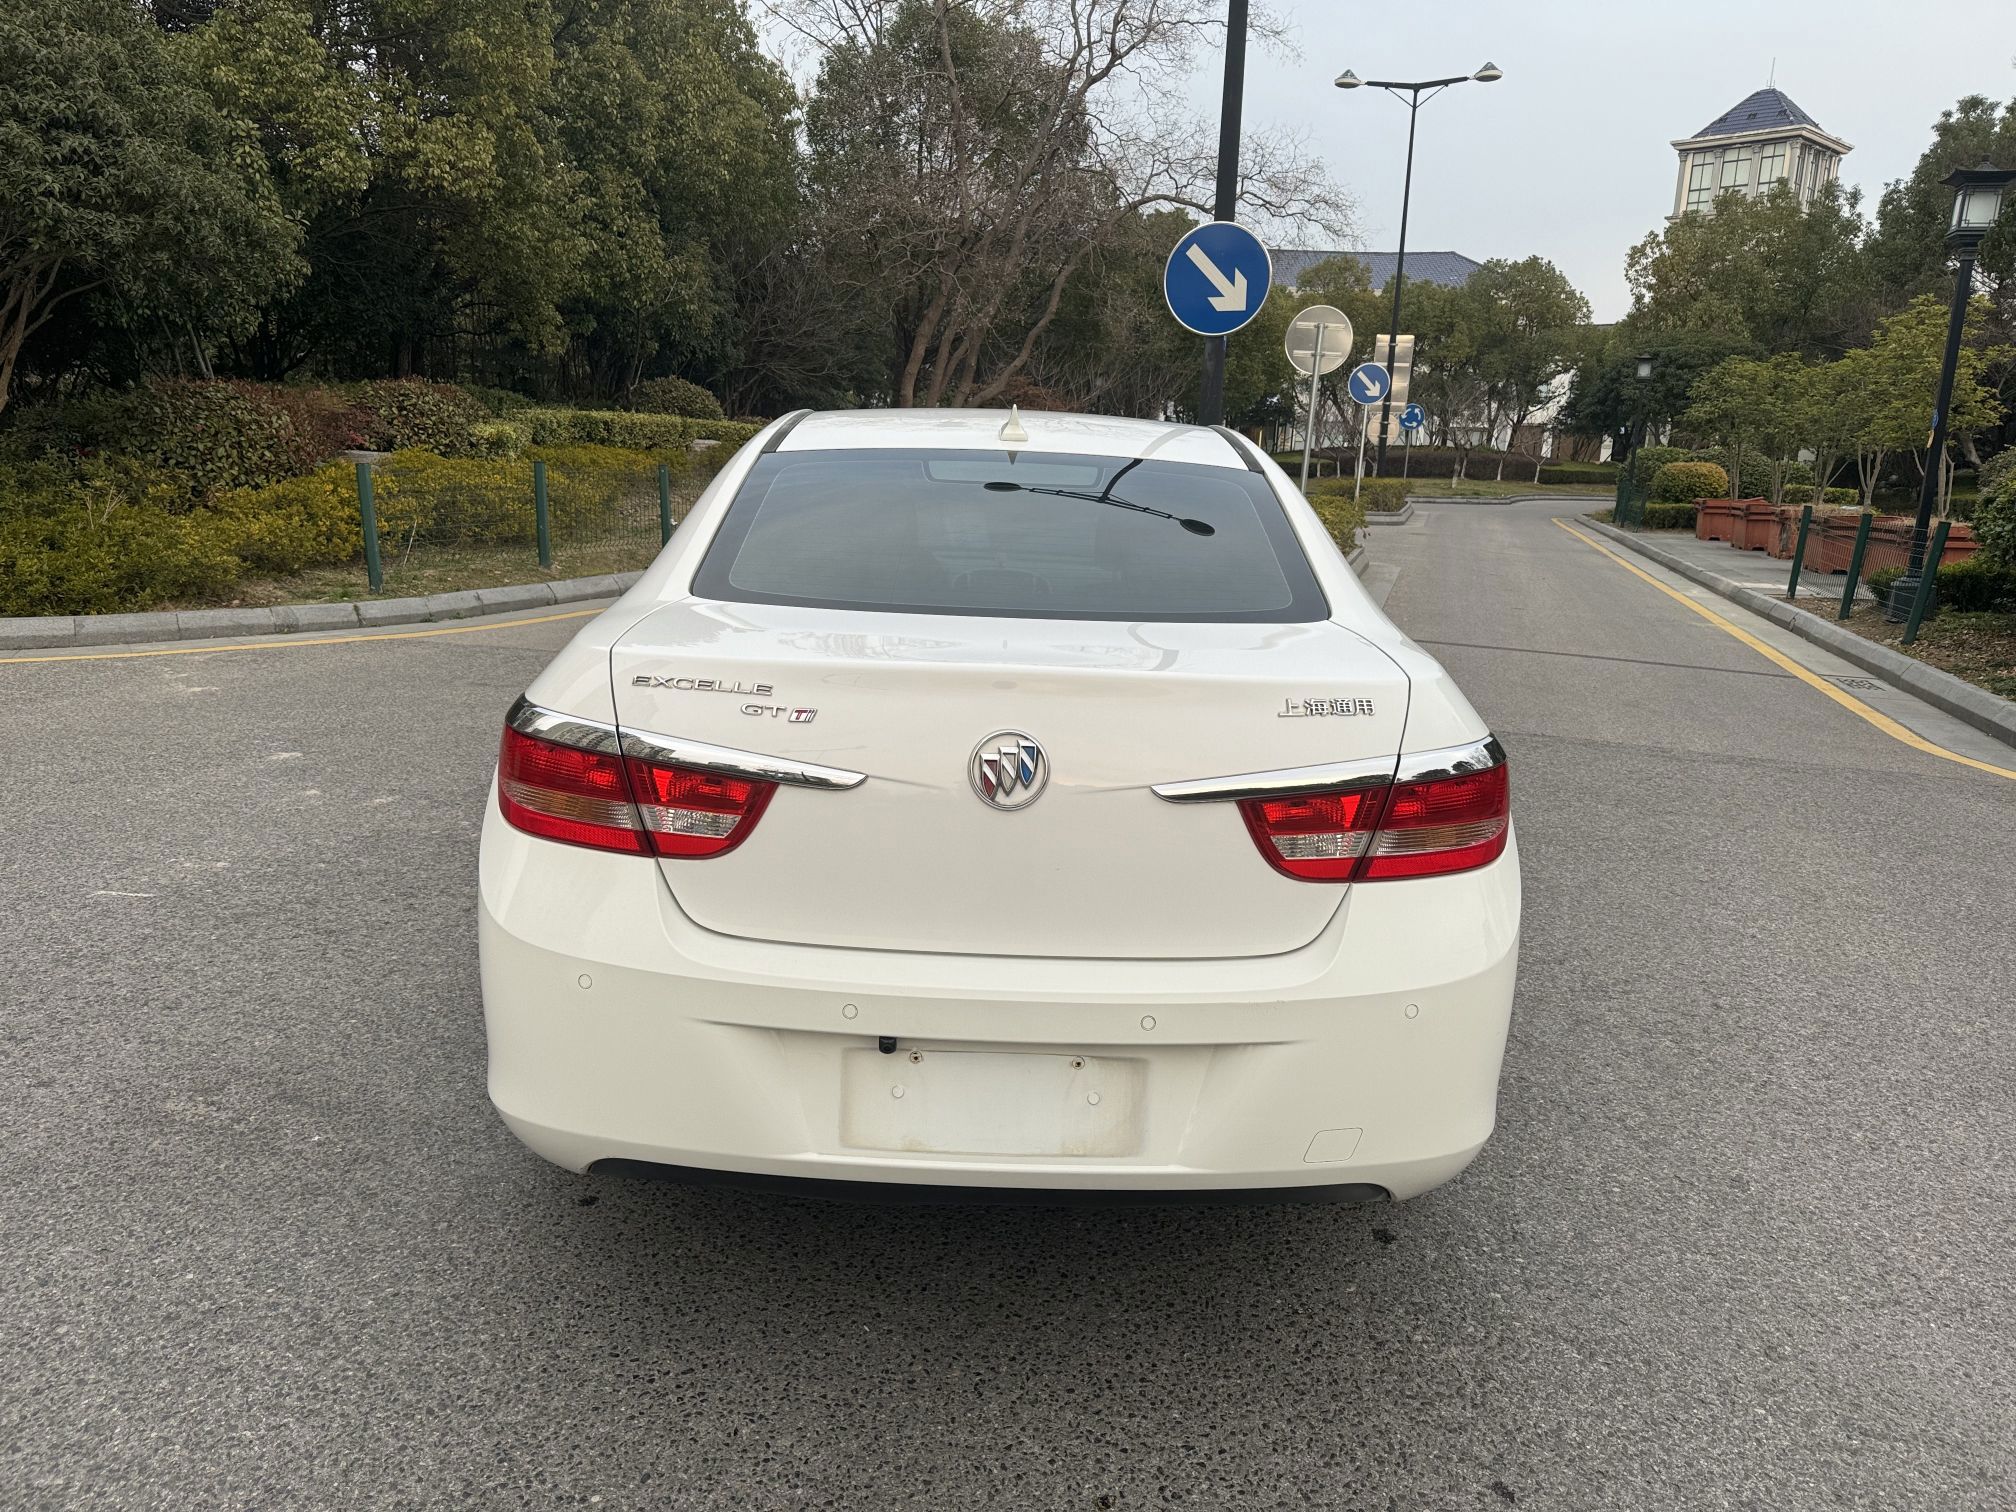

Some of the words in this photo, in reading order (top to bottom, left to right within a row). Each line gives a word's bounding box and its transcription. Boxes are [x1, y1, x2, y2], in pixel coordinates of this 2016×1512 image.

[632, 675, 773, 696] EXCELLE
[1278, 698, 1375, 718] 上海通用
